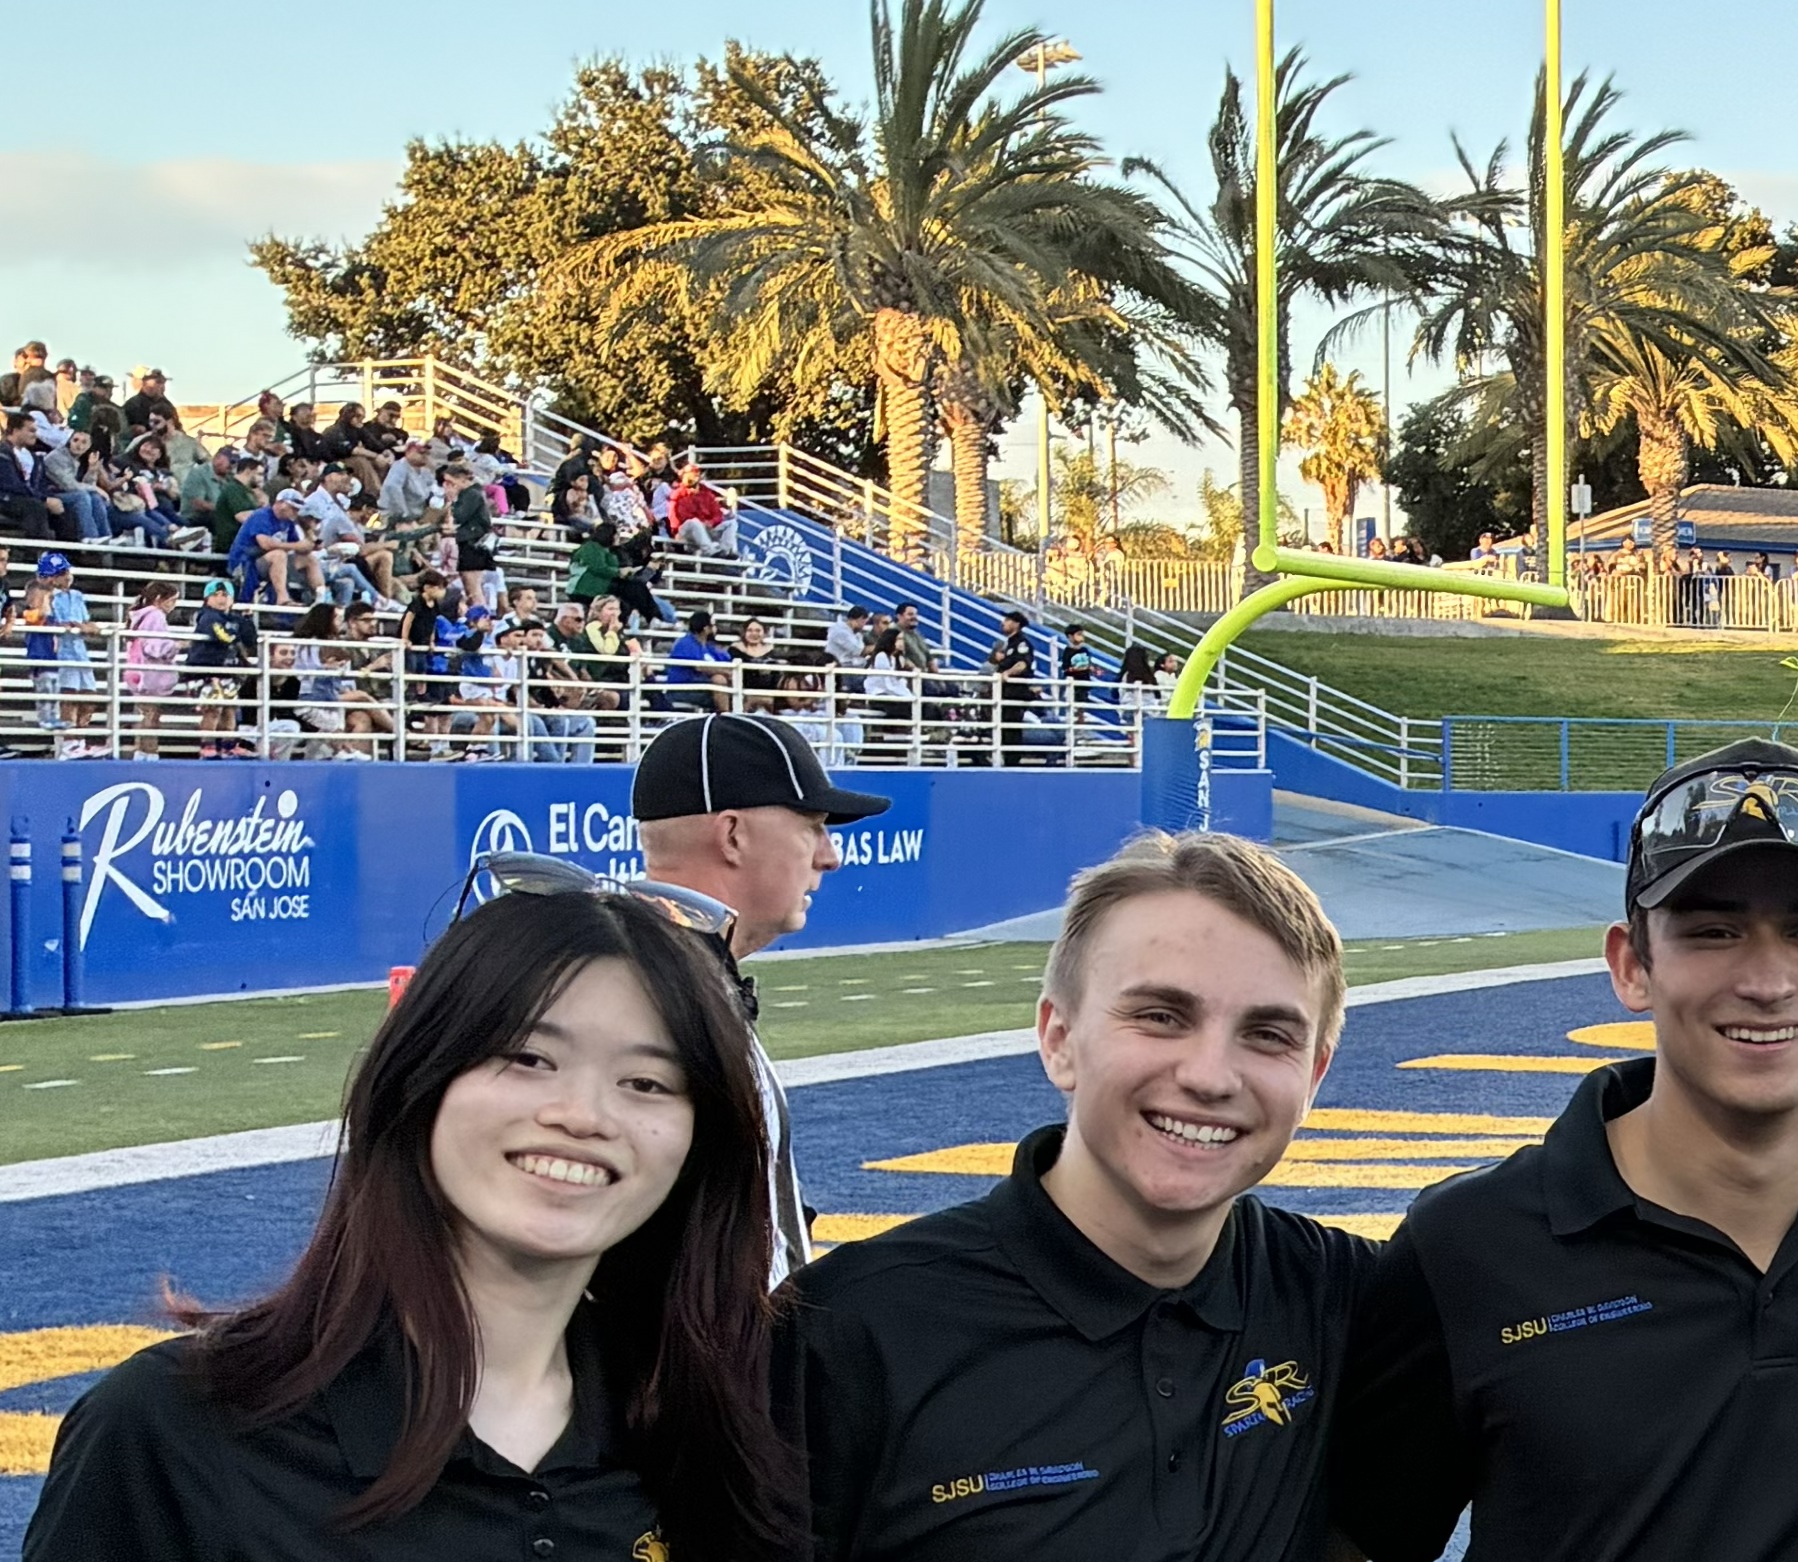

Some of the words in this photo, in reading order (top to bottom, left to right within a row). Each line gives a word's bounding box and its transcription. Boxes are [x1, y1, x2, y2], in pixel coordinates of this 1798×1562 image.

[549, 801, 579, 854] El
[878, 828, 924, 865] LAW
[79, 782, 306, 953] Rubenstein
[152, 856, 311, 895] SHOWROOM
[230, 898, 266, 921] SAN
[268, 894, 311, 920] JOSE
[1501, 1316, 1548, 1344] SJSU
[931, 1474, 985, 1503] SJSU
